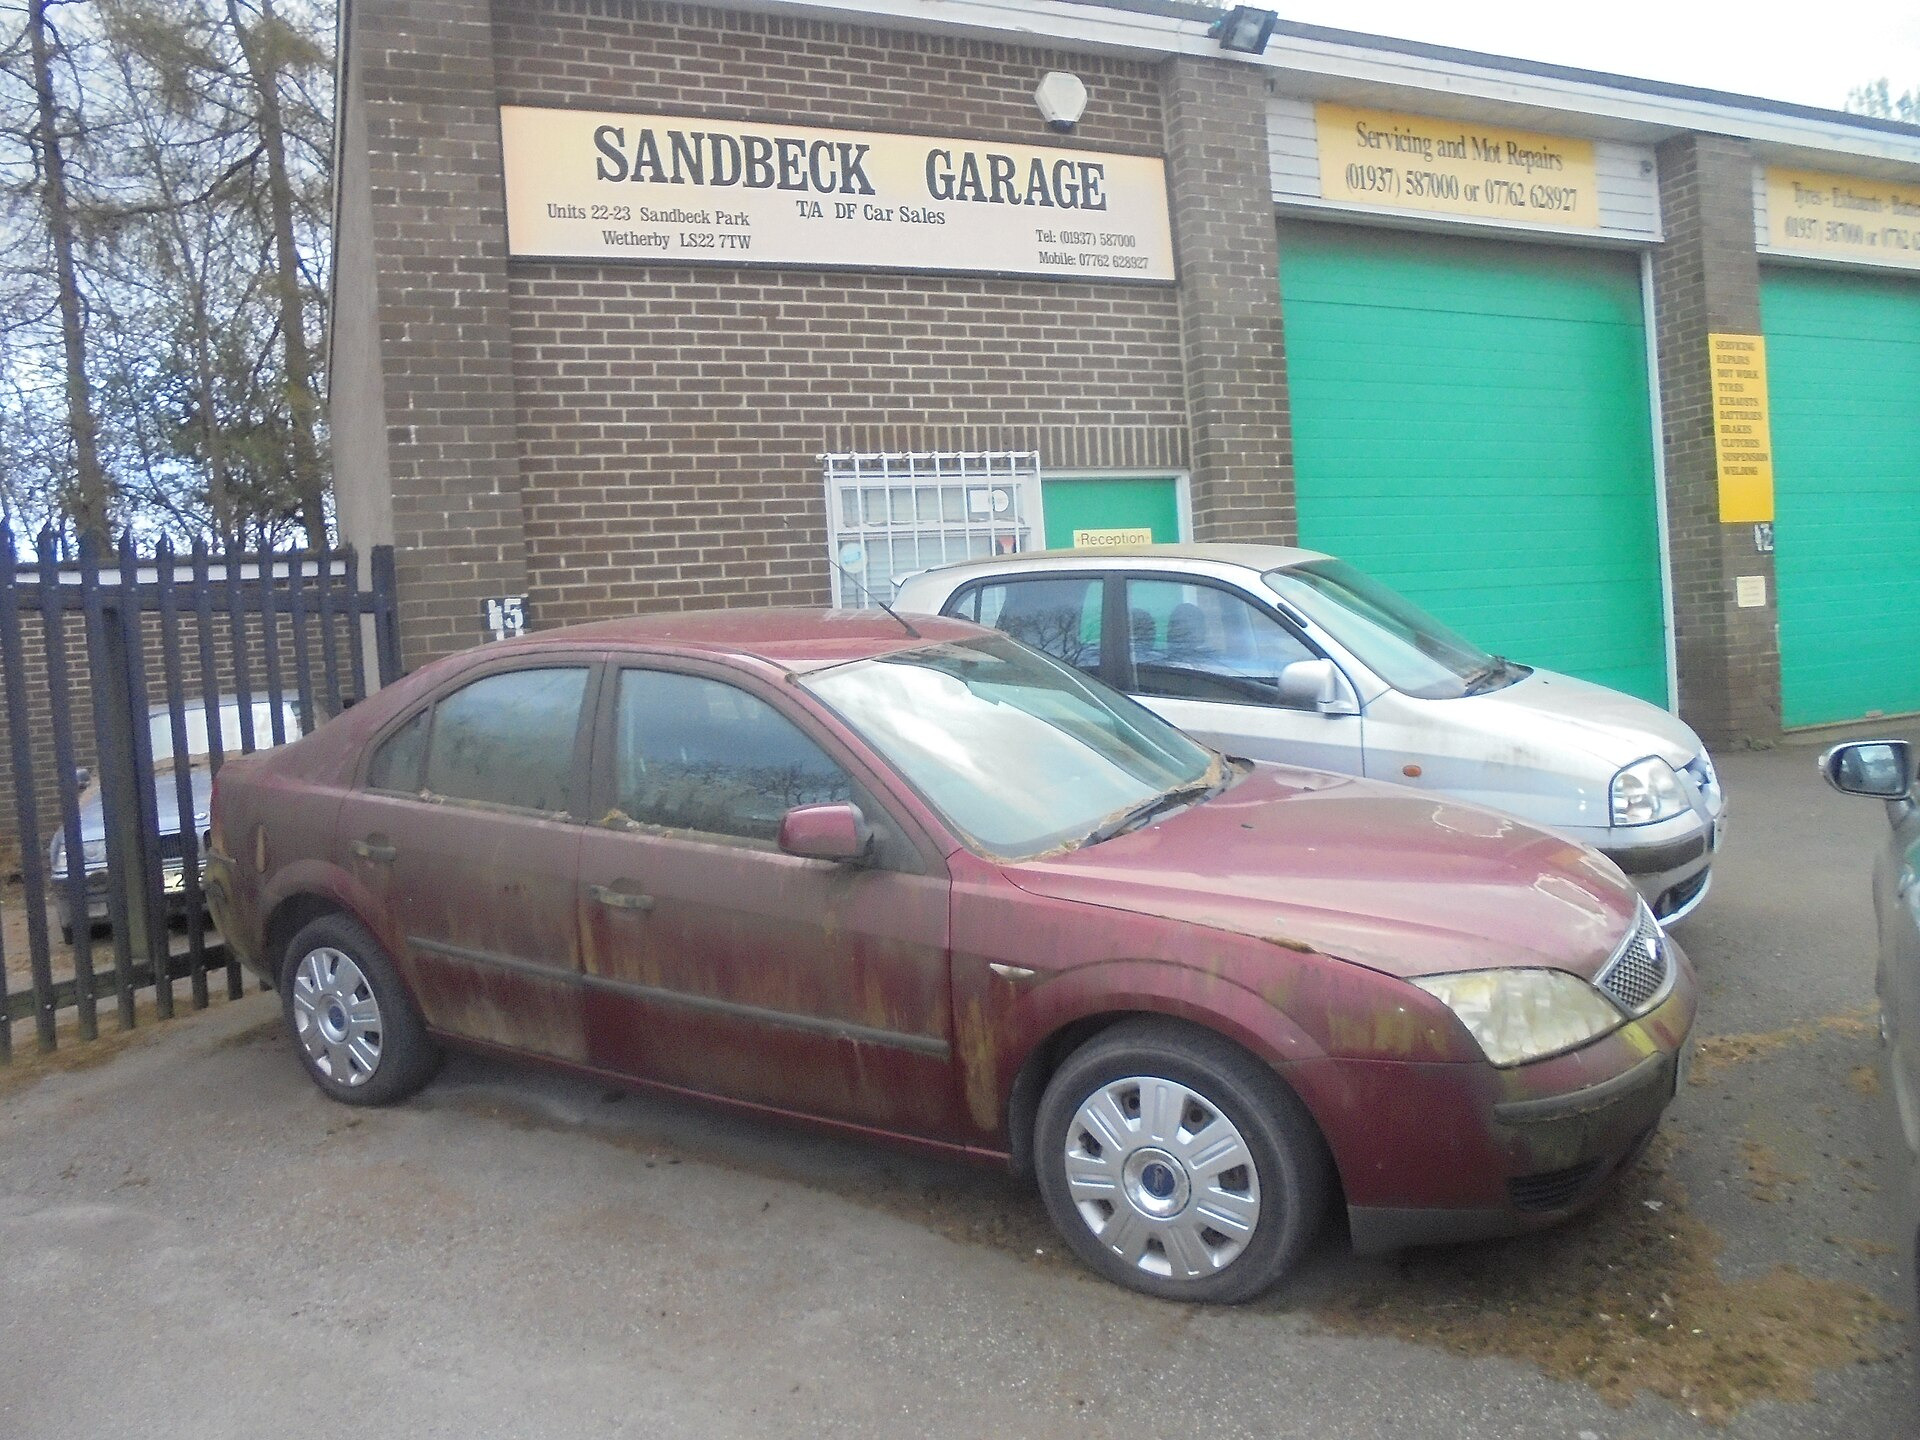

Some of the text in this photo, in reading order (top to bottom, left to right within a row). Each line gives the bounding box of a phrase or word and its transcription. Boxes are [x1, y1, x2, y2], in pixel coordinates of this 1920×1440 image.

[1356, 121, 1563, 173] Servicing and Mot Repairs
[593, 124, 1107, 211] SANDBECK GARAGE
[1345, 163, 1577, 211] (01937) 587000 or 07762 628927
[547, 203, 749, 226] Units 22-23 Sandbeck Park
[796, 200, 945, 225] T/A DF Car Sales
[602, 230, 751, 250] Wetherby LS22 7TW
[1036, 229, 1136, 248] Tel: (01937) 587000
[1039, 252, 1149, 270] Mobile: 07762 628927
[1080, 532, 1145, 547] Reception
